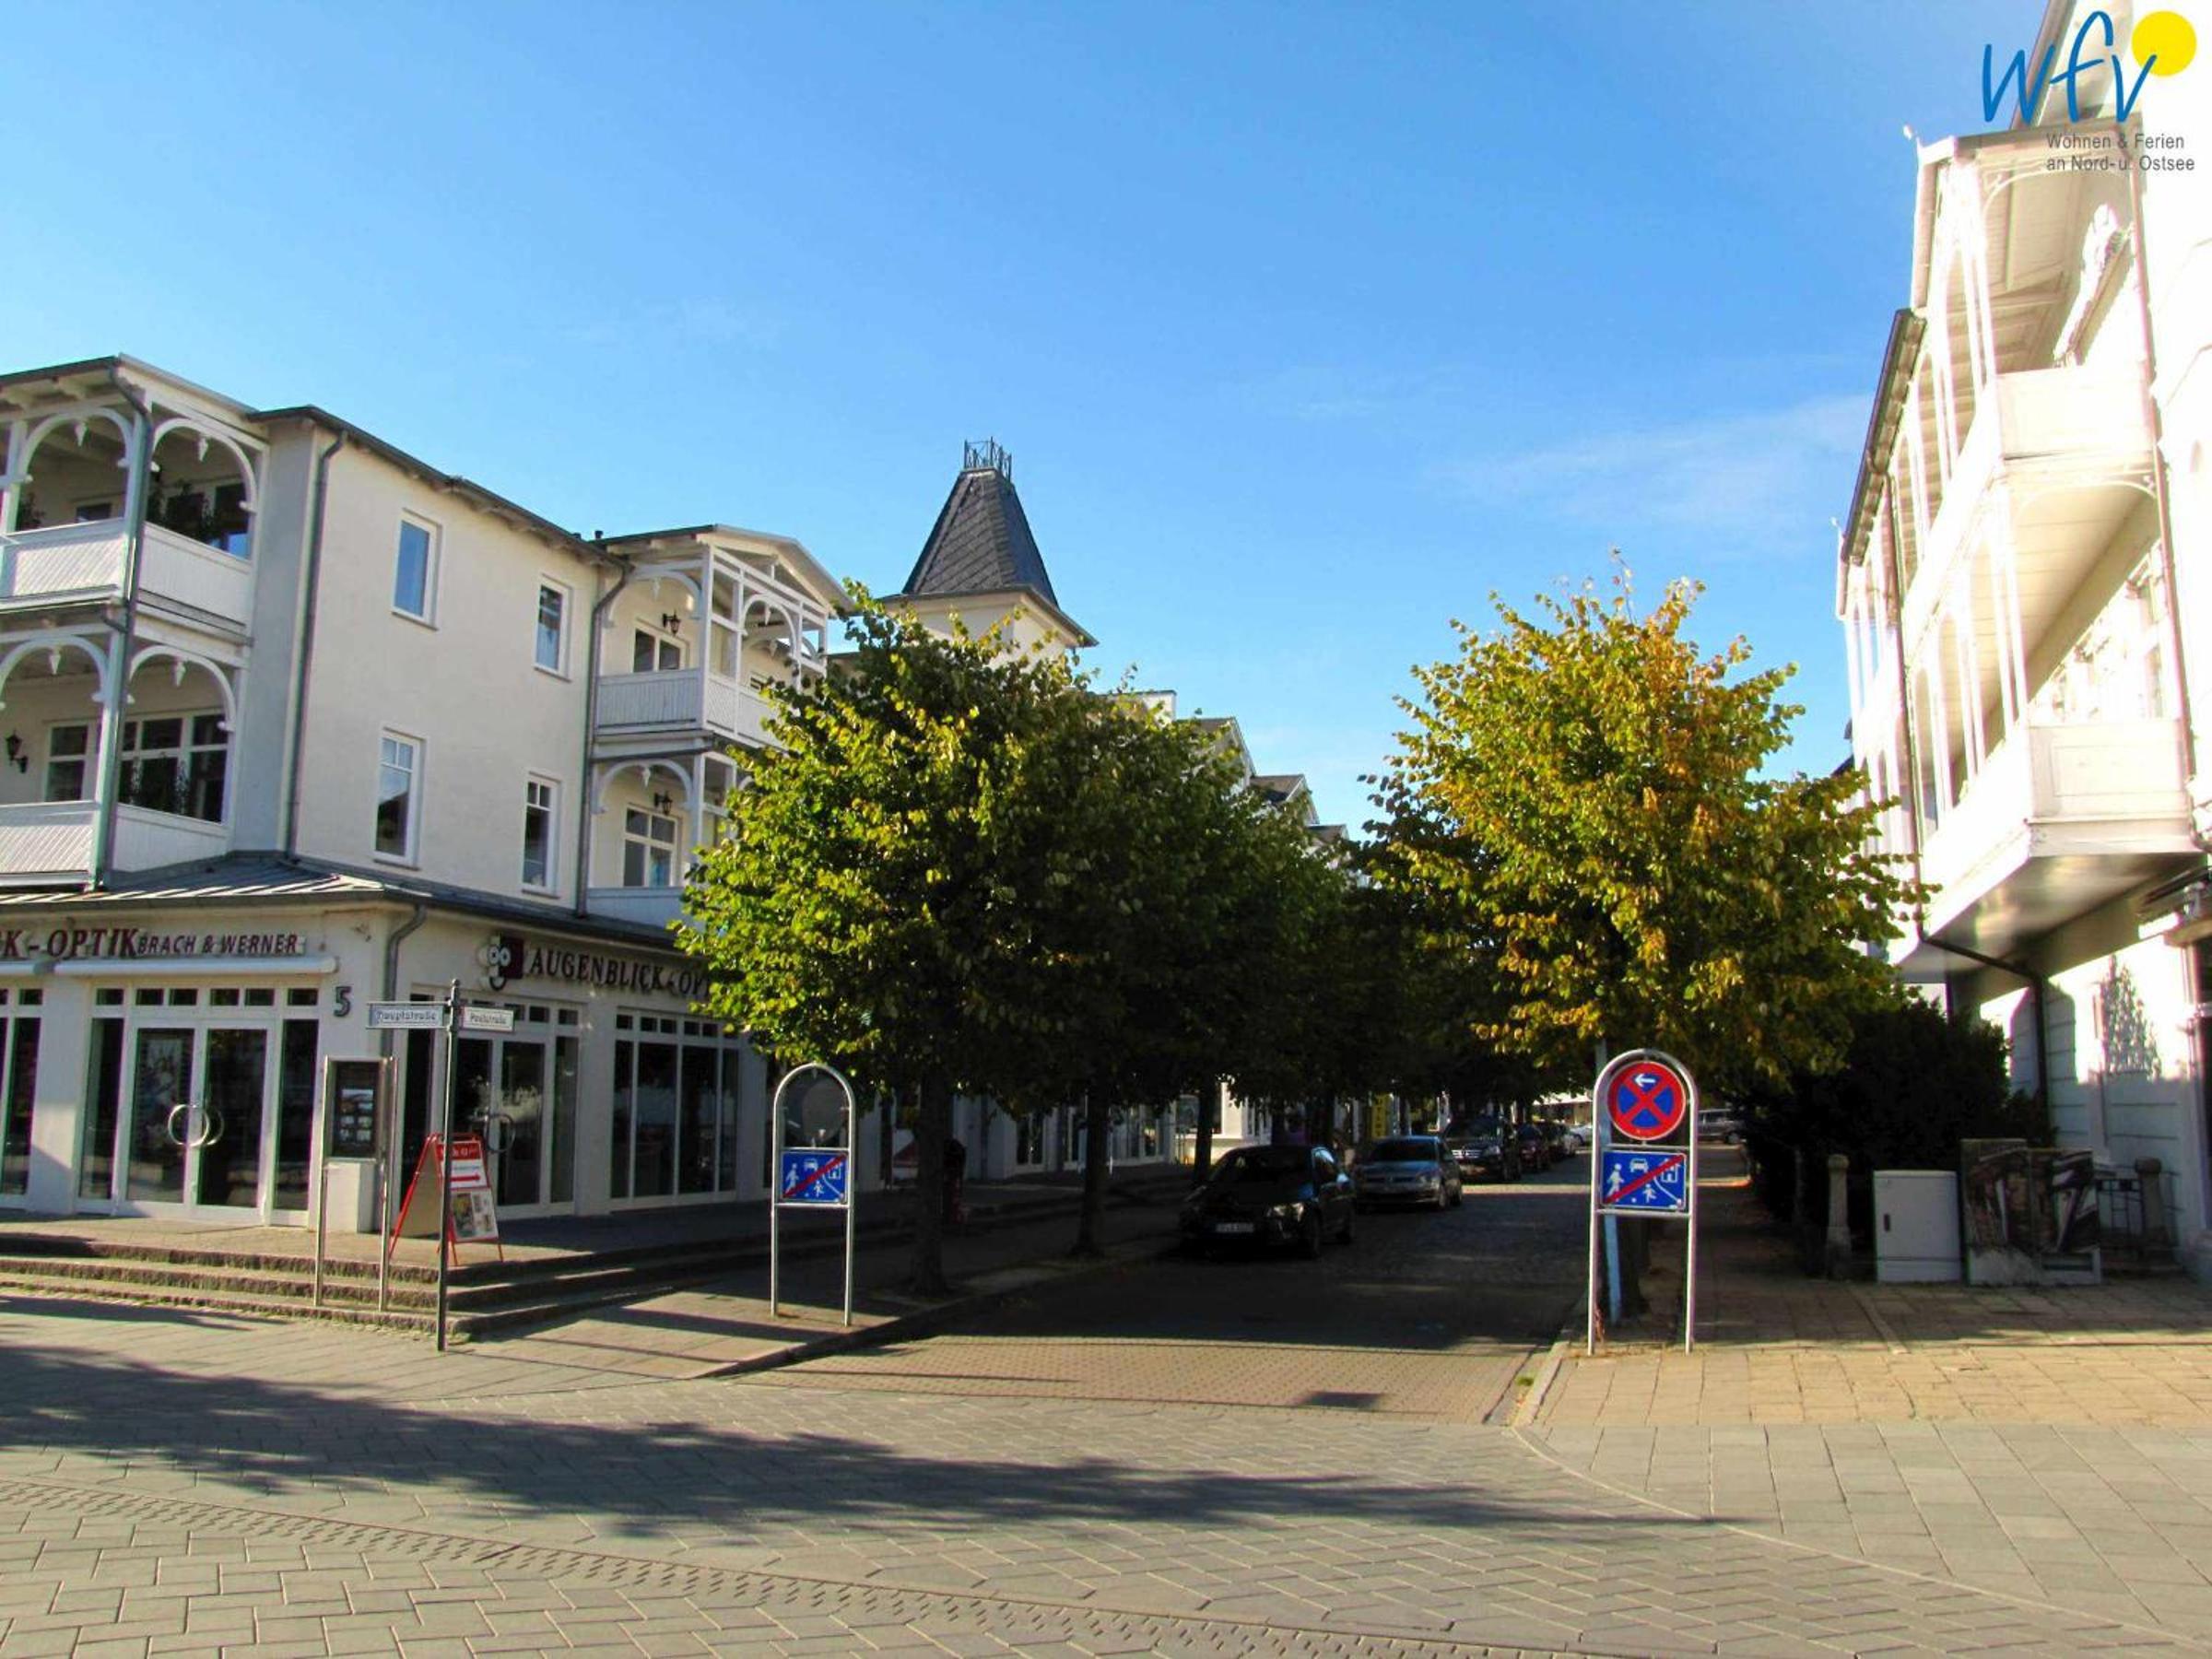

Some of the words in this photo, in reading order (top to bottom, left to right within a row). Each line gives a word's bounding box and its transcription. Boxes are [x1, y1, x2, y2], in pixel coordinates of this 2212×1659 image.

[138, 934, 197, 954] BRACH
[201, 934, 214, 954] &
[220, 934, 298, 954] WERNER
[333, 986, 352, 1017] 5
